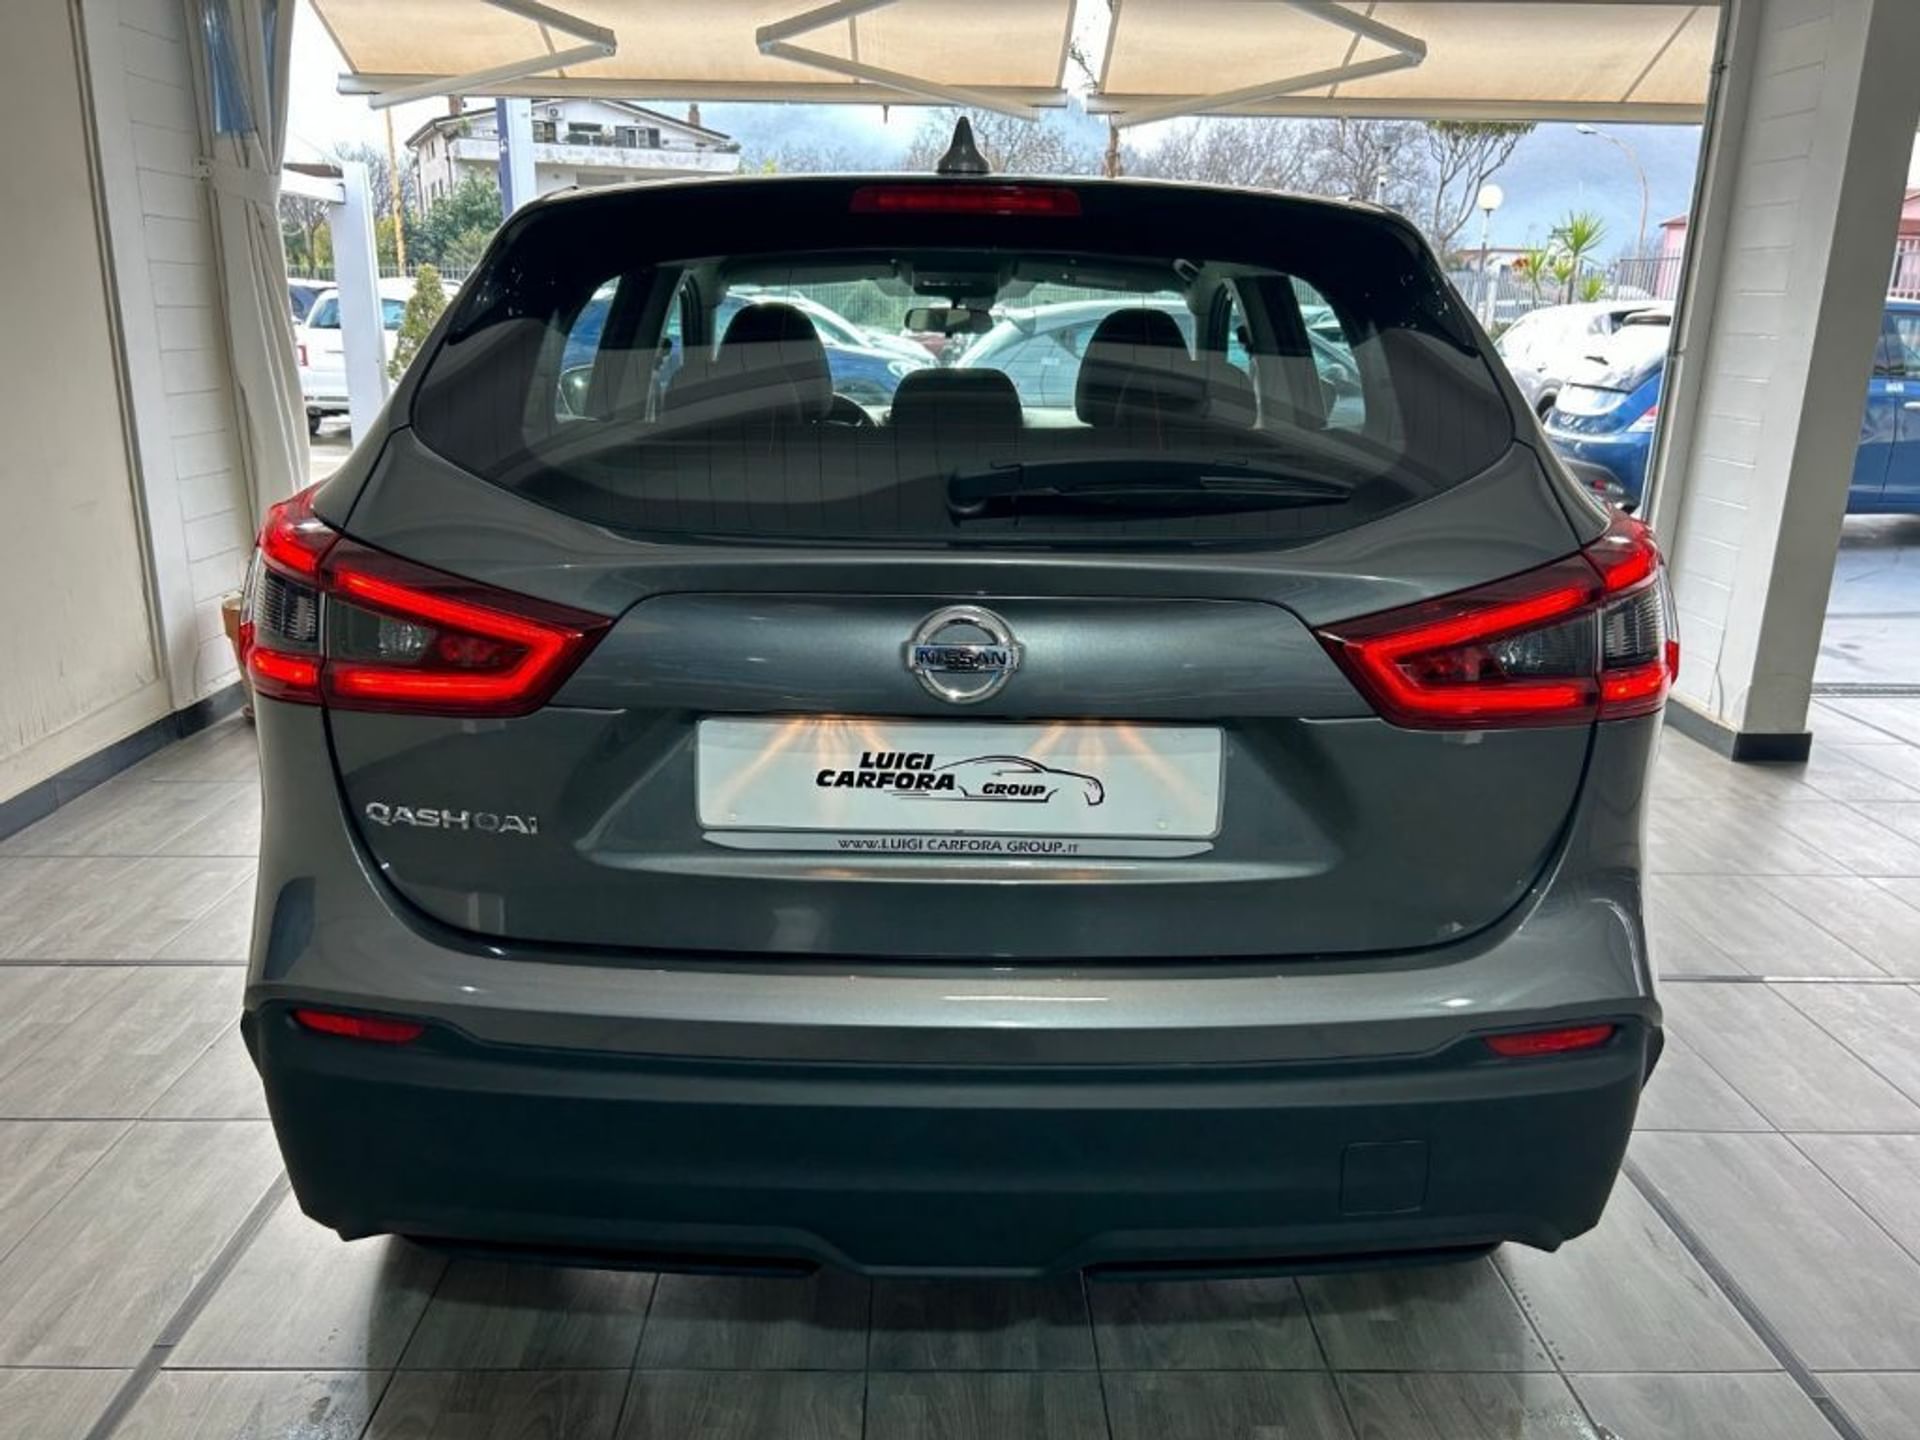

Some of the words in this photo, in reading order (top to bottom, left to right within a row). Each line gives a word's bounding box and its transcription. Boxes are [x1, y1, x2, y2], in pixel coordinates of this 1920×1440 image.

[918, 650, 1007, 667] NISSAN
[859, 751, 935, 769] LUIGI
[815, 769, 955, 791] CARFORA
[981, 782, 1046, 796] GROUP
[926, 838, 1003, 852] CARFORA
